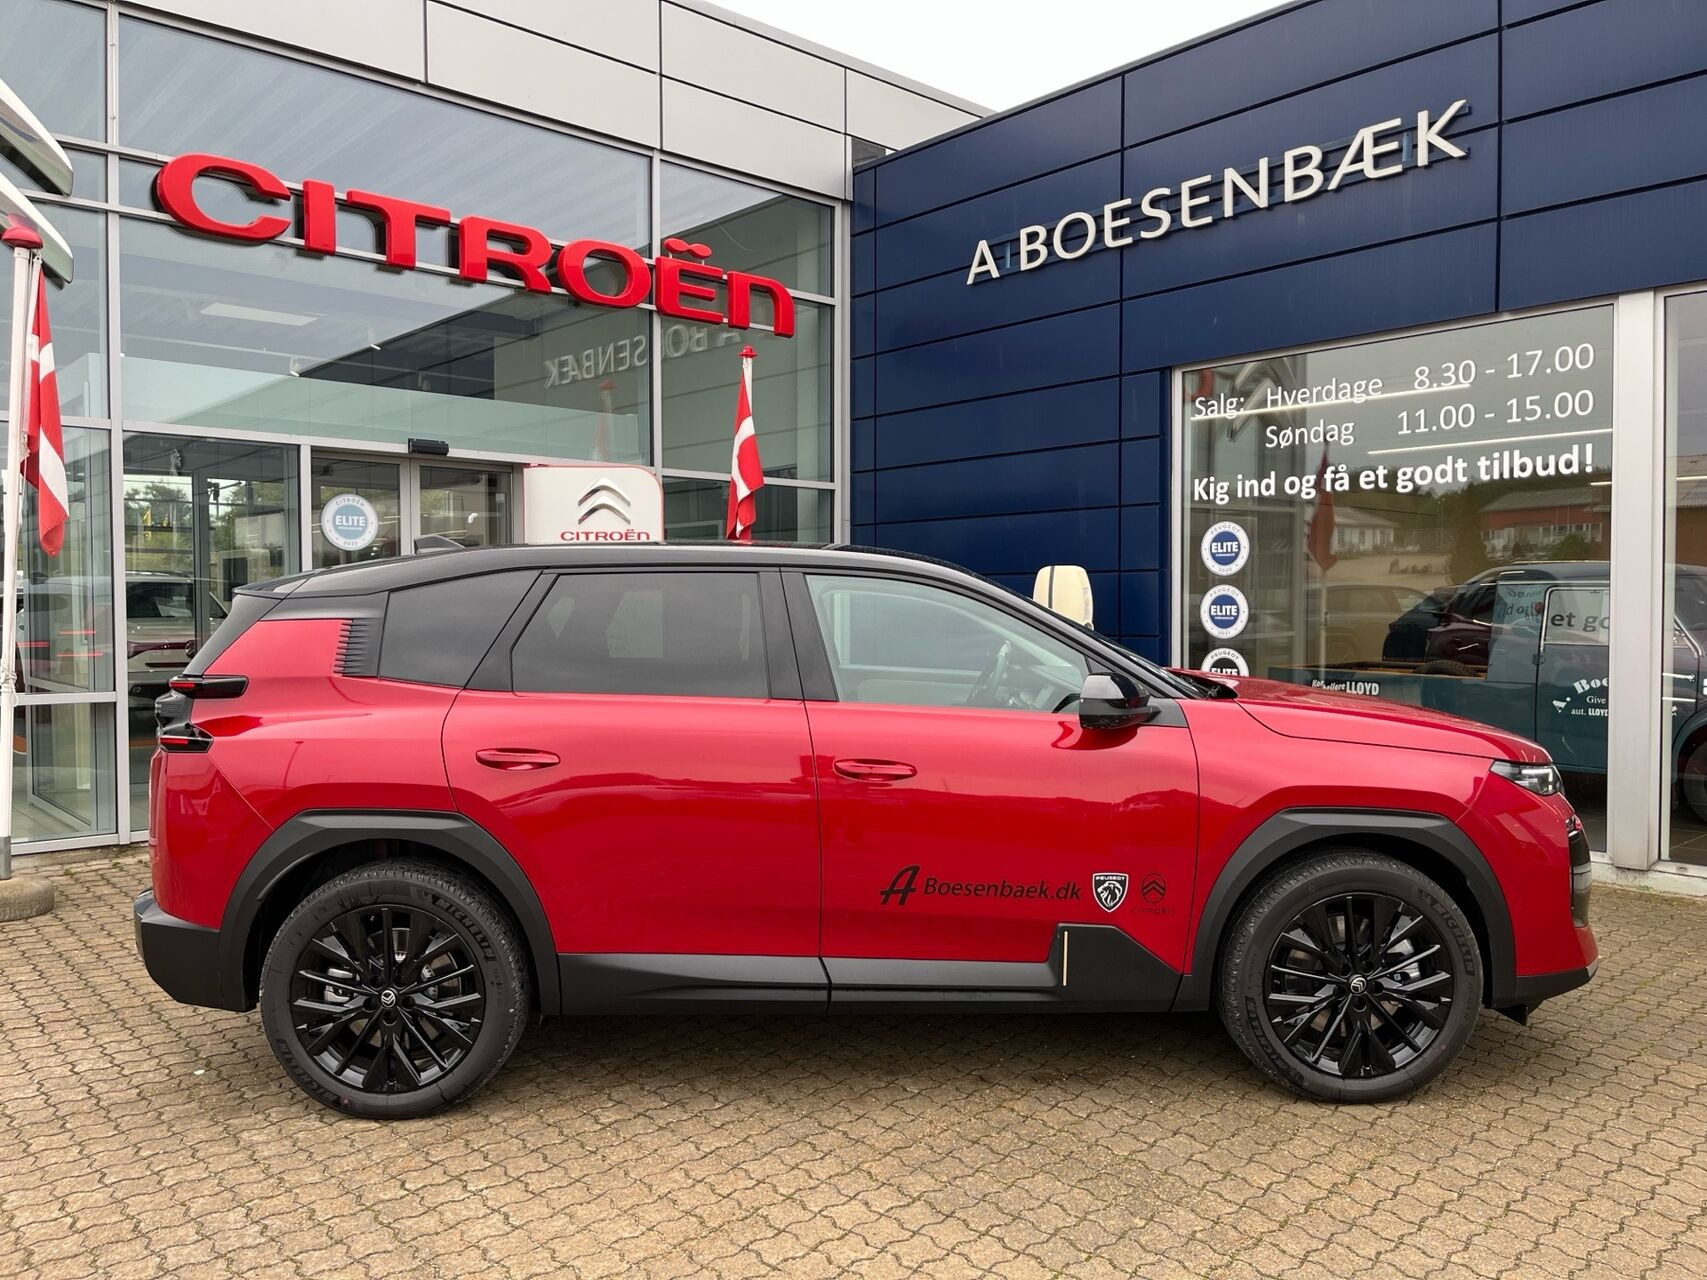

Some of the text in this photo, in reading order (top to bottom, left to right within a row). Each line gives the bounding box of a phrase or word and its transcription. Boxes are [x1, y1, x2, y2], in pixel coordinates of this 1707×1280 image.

[966, 98, 1469, 286] A BOESENBÆK
[1195, 392, 1245, 419] Salg:
[1267, 377, 1382, 409] Hverdage
[1414, 359, 1476, 391] 8.30
[1506, 343, 1594, 379] 17.00
[1265, 419, 1355, 449] Søndag
[1397, 403, 1475, 435] 11.00
[1506, 389, 1594, 424] 15.00
[1193, 443, 1594, 505] Kig ind og få et godt tilbud!
[335, 515, 366, 527] ELITE
[1210, 524, 1241, 535] PEUGEOT
[1211, 541, 1239, 553] ELITE
[1210, 586, 1239, 598] PEUGEOT
[1211, 604, 1238, 616] ELITE
[1551, 610, 1576, 628] et
[1211, 650, 1240, 660] PEUGEOT
[1346, 681, 1379, 696] LLOYD
[1586, 695, 1606, 705] Give
[1571, 707, 1586, 716] aut.
[880, 865, 1081, 905] A Boesenbaek.dk
[435, 895, 495, 960] MICHELIN
